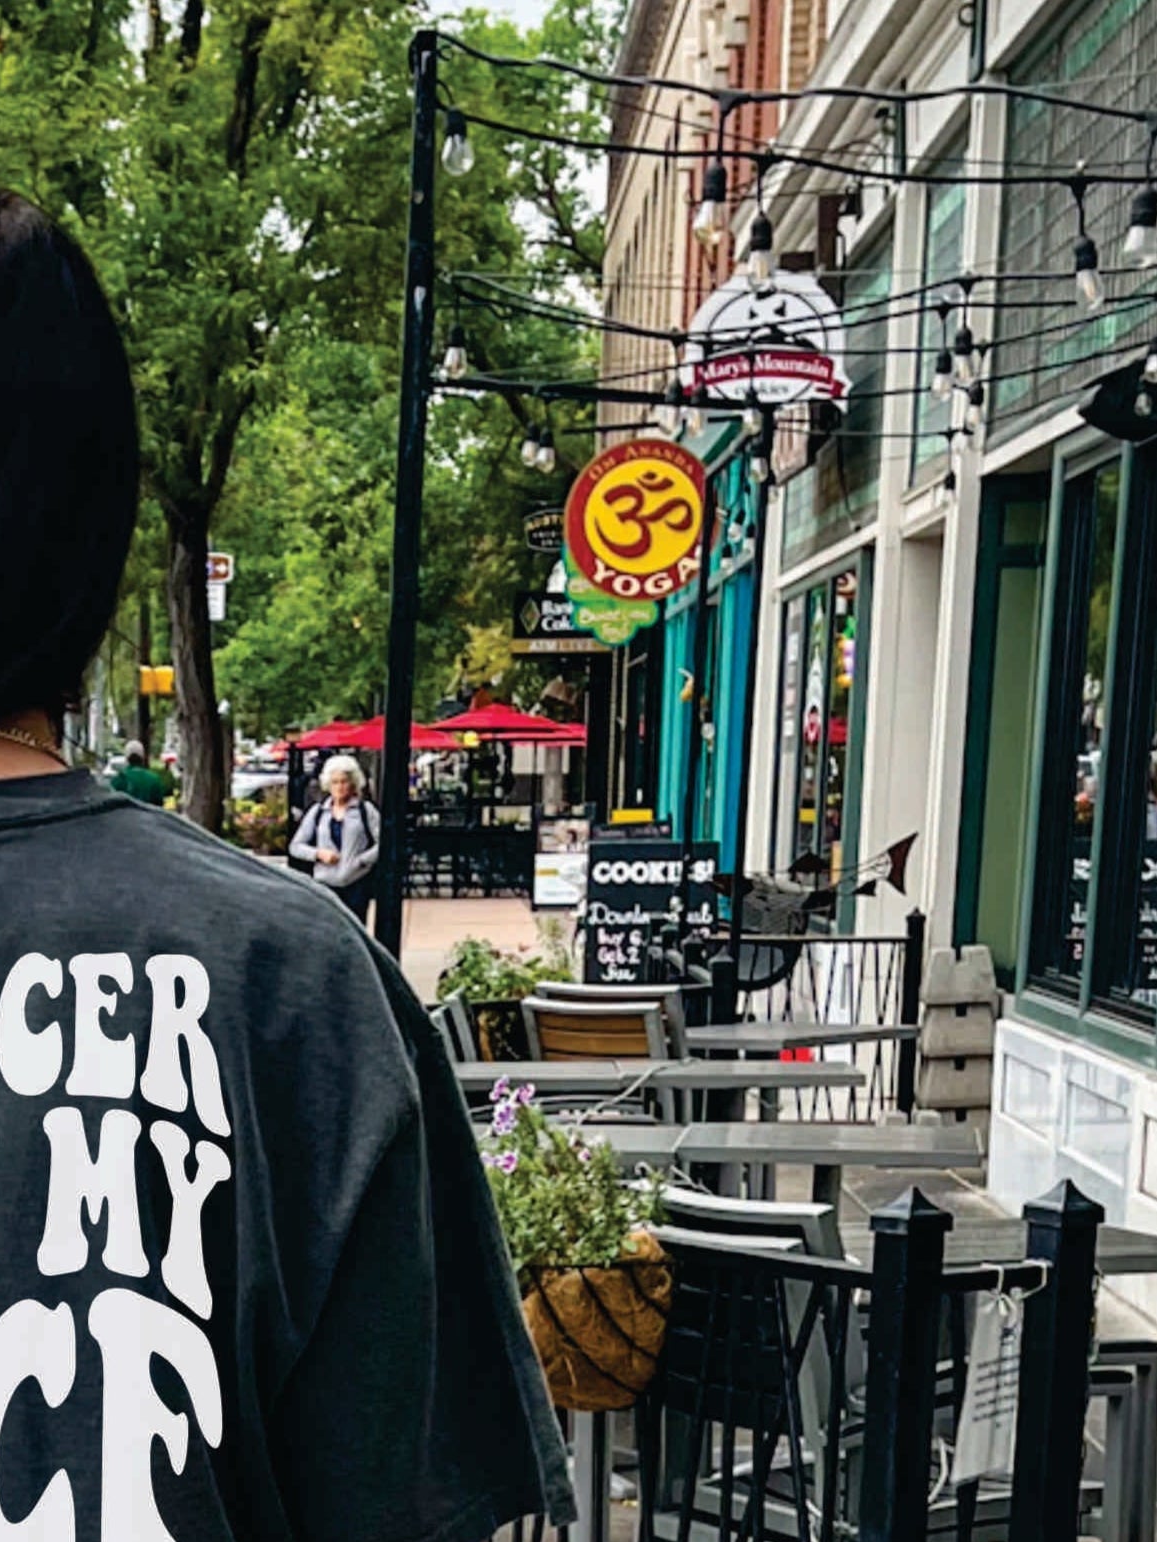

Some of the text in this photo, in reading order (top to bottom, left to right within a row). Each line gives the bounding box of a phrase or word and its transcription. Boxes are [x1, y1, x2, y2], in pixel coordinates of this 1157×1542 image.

[754, 353, 830, 378] Mountain
[593, 545, 702, 597] YOGA
[37, 1107, 231, 1319] MY
